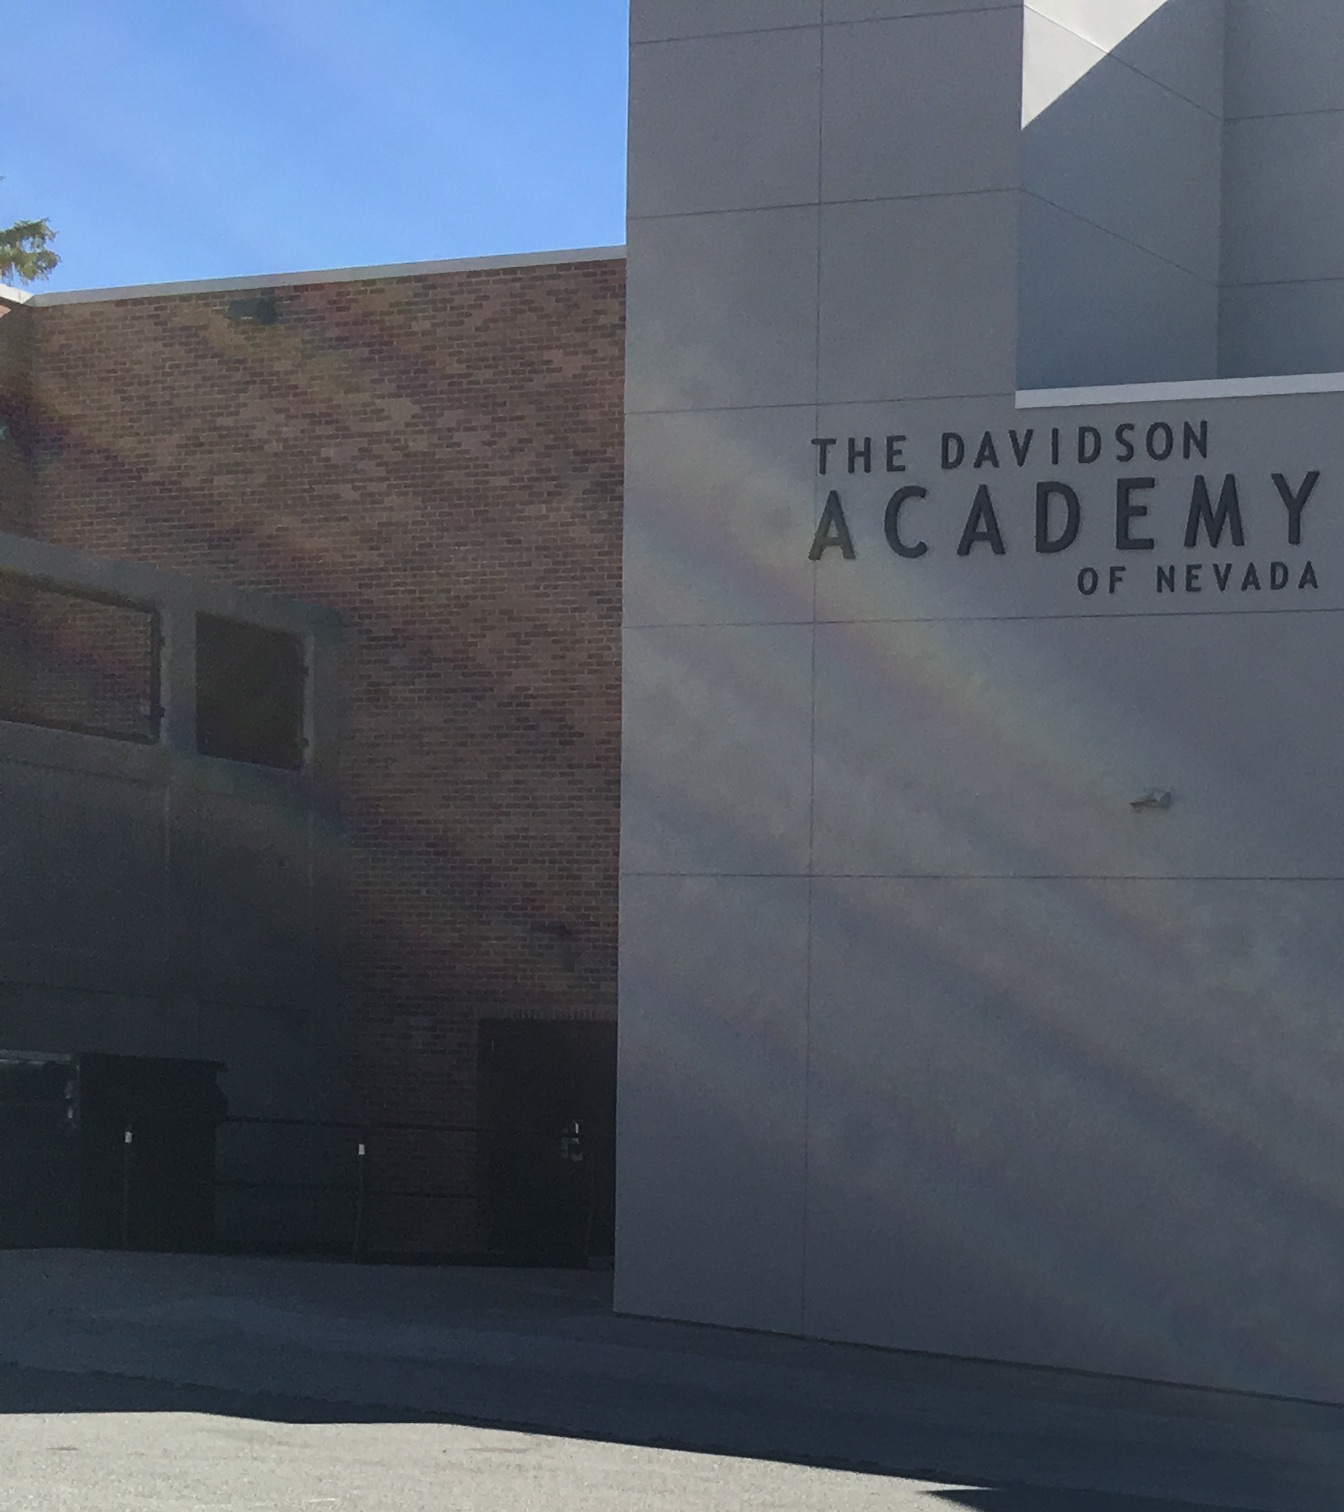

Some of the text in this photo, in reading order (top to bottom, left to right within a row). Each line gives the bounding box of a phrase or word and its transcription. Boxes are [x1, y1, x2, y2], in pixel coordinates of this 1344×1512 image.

[811, 419, 1210, 476] THE DAVIDSON
[807, 470, 1321, 562] ACADEMY
[1077, 560, 1320, 596] OF NEVADA
